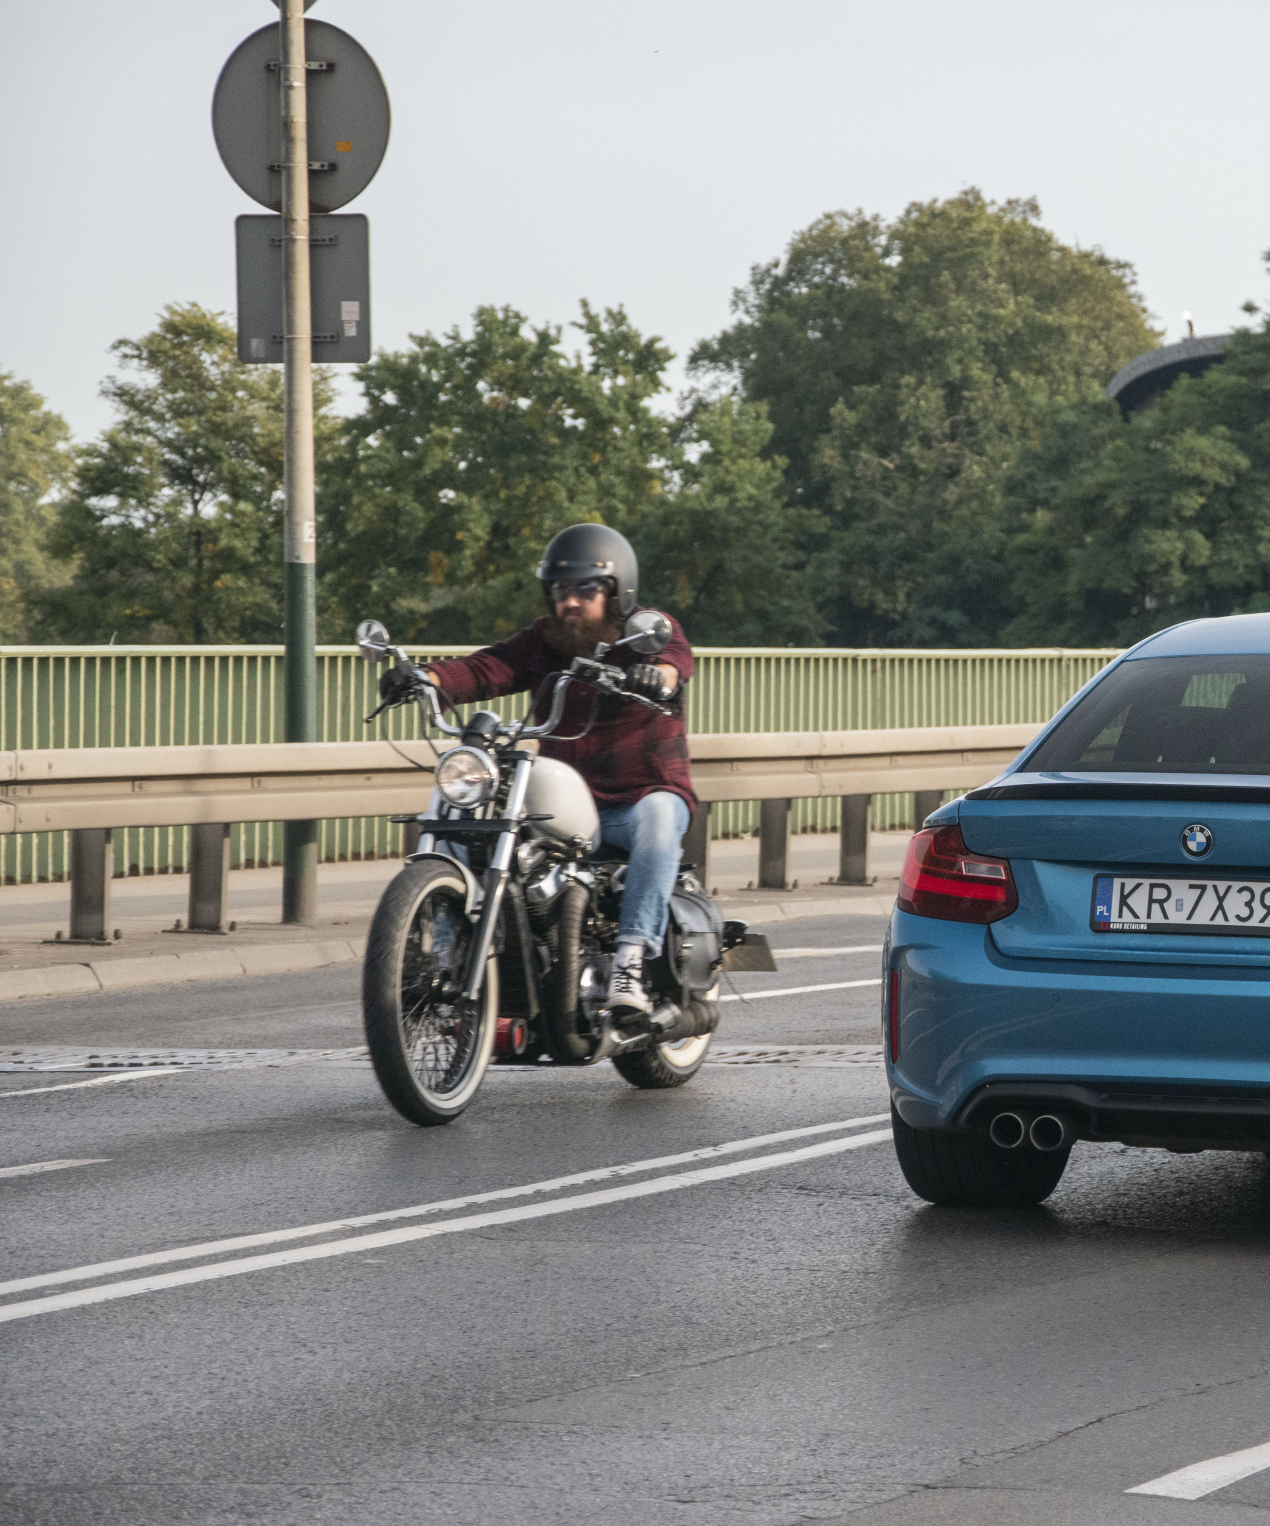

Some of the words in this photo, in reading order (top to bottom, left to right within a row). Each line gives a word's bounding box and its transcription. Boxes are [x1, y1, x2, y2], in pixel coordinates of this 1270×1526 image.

[1183, 825, 1211, 837] BMW
[1117, 881, 1173, 920] KR
[1096, 905, 1109, 916] PL
